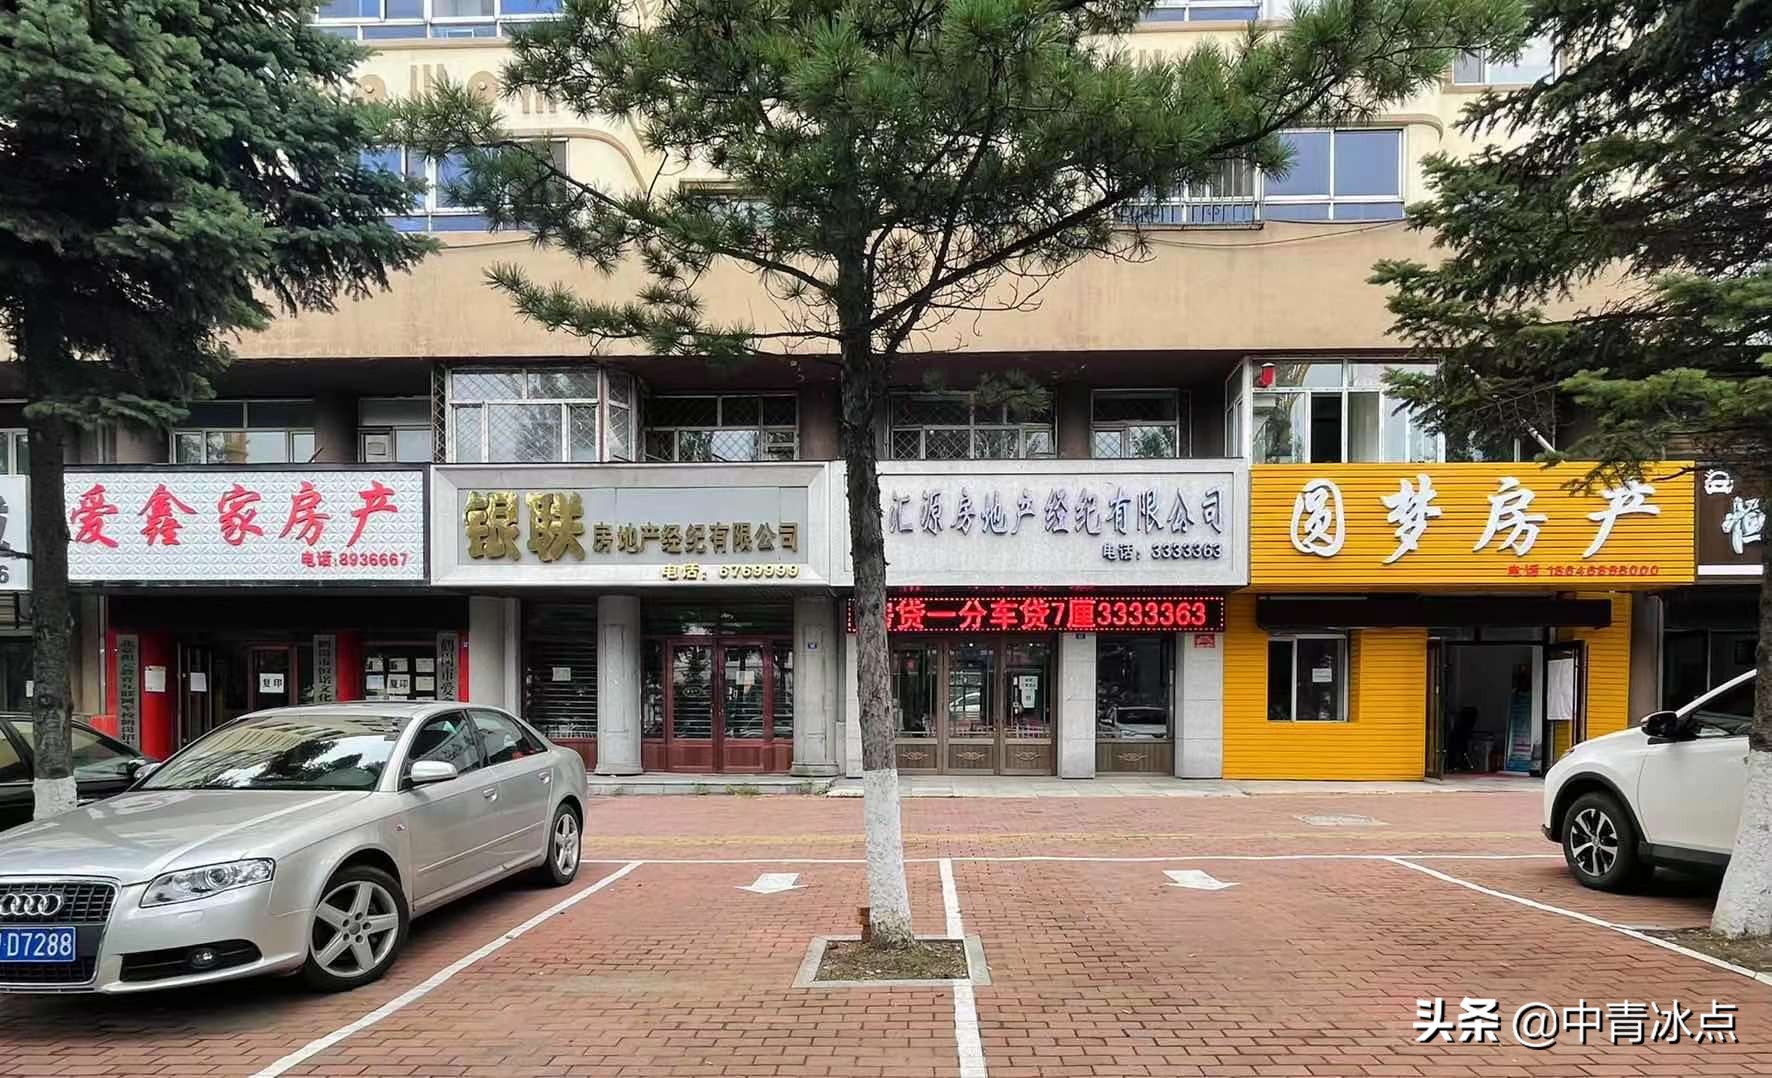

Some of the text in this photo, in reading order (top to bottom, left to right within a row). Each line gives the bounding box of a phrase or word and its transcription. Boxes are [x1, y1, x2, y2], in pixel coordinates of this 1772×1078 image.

[70, 479, 399, 549] 爱鑫家房产
[464, 490, 799, 563] 银联 房地产经纪有限公司
[888, 487, 1225, 536] 汇源房地产经纪有限公司
[1290, 473, 1660, 565] 圆梦房产
[886, 599, 1207, 631] 贷一分车贷7厘3333363
